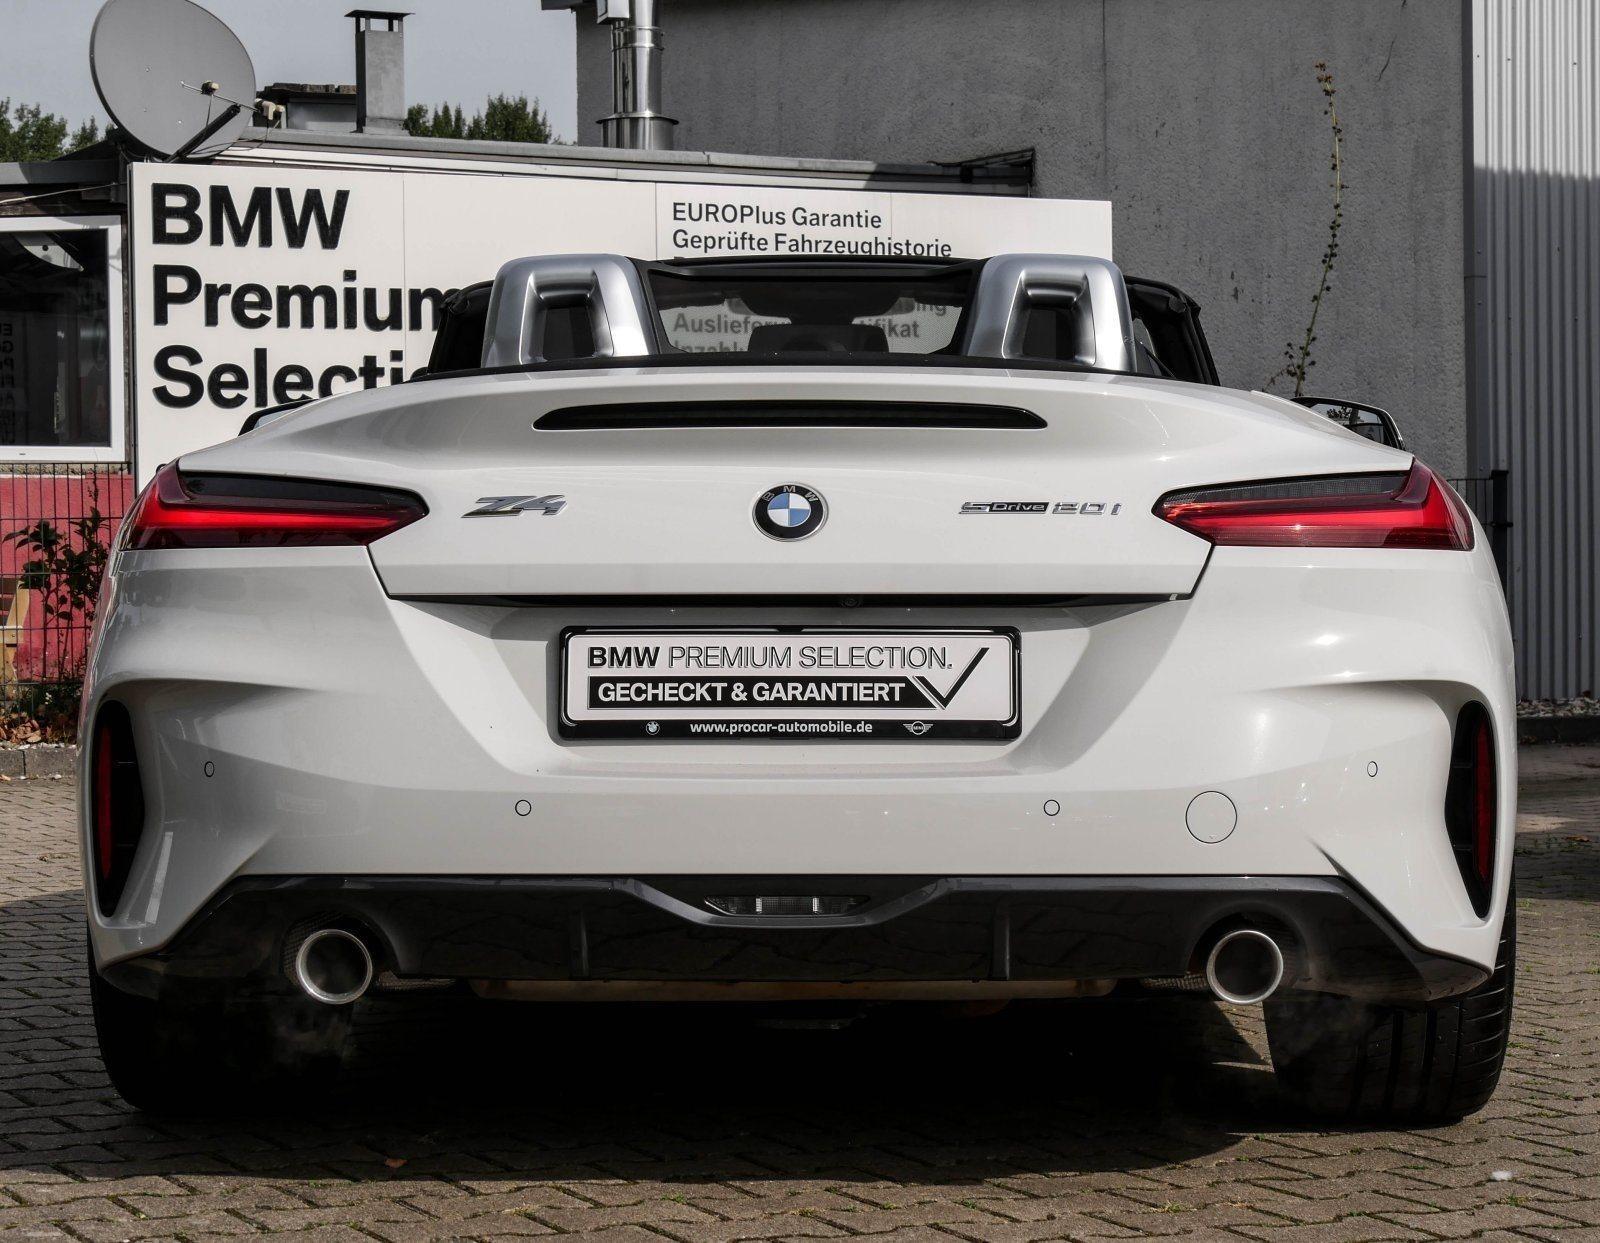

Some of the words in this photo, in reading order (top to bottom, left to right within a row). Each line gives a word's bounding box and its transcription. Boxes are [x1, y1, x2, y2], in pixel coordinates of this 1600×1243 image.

[151, 182, 350, 249] BMW
[672, 202, 786, 225] EUROPlus
[791, 206, 882, 229] Garantie
[672, 228, 769, 253] Geprüfte
[774, 233, 952, 257] Fahrzeughistorie
[152, 264, 461, 332] Premium
[152, 344, 429, 410] Selecti
[460, 494, 568, 519] Z4
[587, 646, 661, 669] BMW
[668, 646, 792, 669] PREMIUM
[798, 645, 953, 670] SELECTION.
[597, 682, 727, 702] GECHECKT
[731, 682, 748, 702] &
[752, 682, 906, 702] GARANTIERT
[689, 721, 873, 736] www.procar-automobile.de
